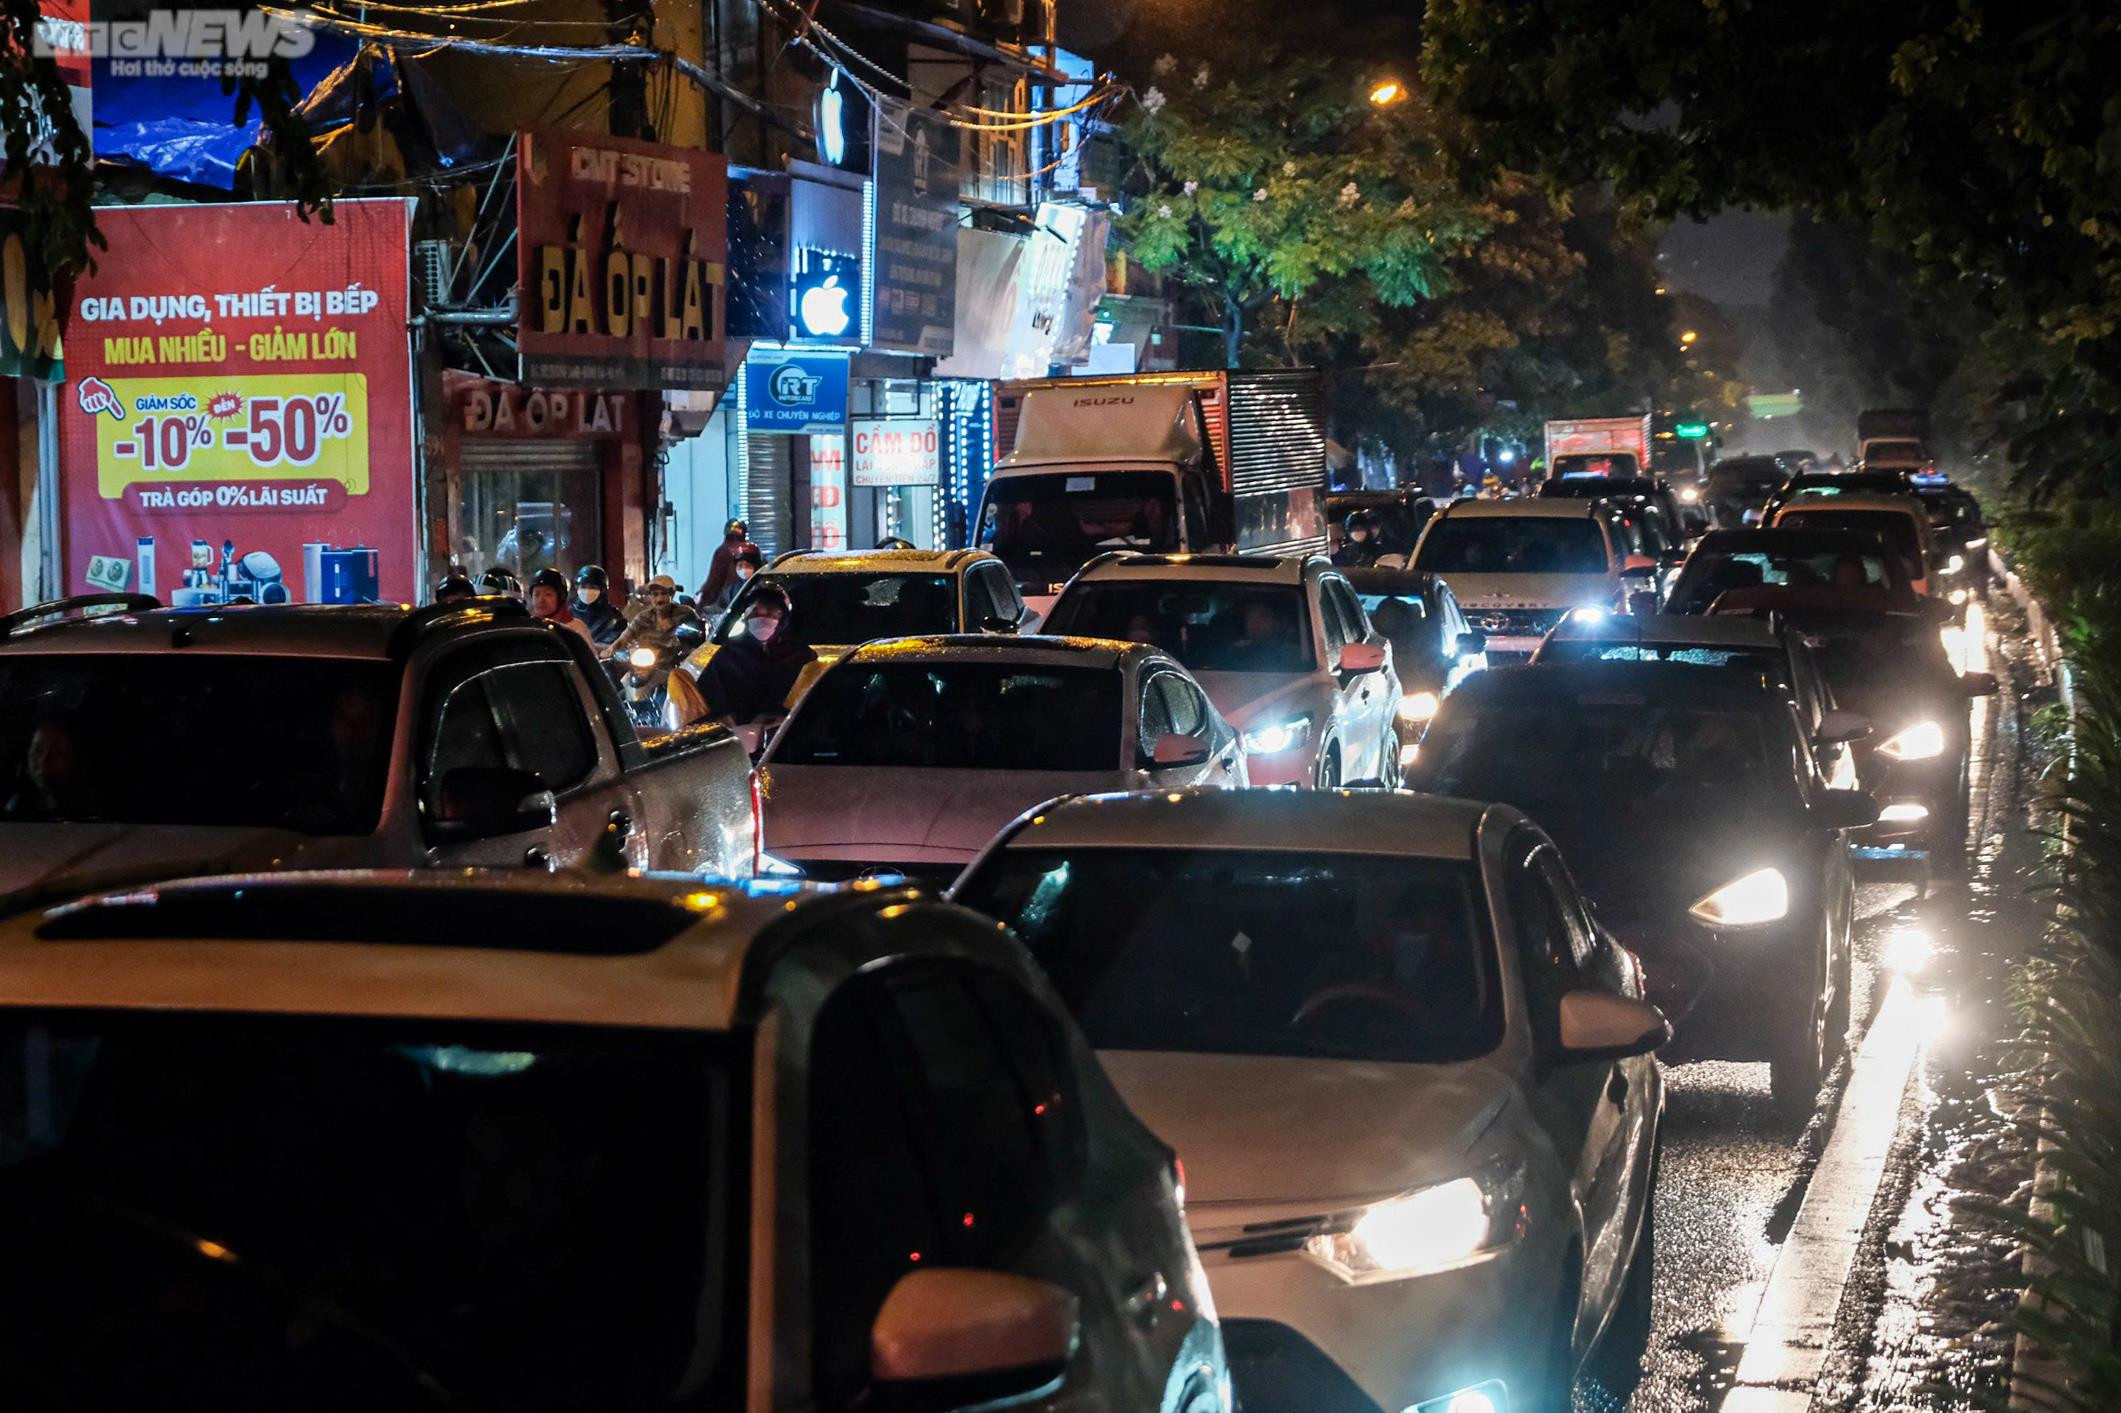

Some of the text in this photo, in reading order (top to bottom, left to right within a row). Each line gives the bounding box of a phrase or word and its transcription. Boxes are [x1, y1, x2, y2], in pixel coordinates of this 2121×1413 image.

[541, 201, 727, 341] ĐÁ ỐP LÁT
[80, 281, 379, 326] GIA DỤNG, THIẾT BỊ BẾP
[104, 337, 156, 365] MUA
[158, 327, 227, 364] NHIỀU
[249, 325, 307, 361] GIẢM
[310, 327, 357, 360] LỚN
[135, 391, 197, 411] GIẢM SỐC
[1073, 396, 1136, 408] ISUZU
[115, 416, 213, 468] -10%
[225, 396, 349, 462] -50%
[177, 486, 214, 508] GÓP
[215, 486, 249, 507] 0%
[249, 486, 278, 507] LÃI
[280, 484, 328, 506] SUẤT
